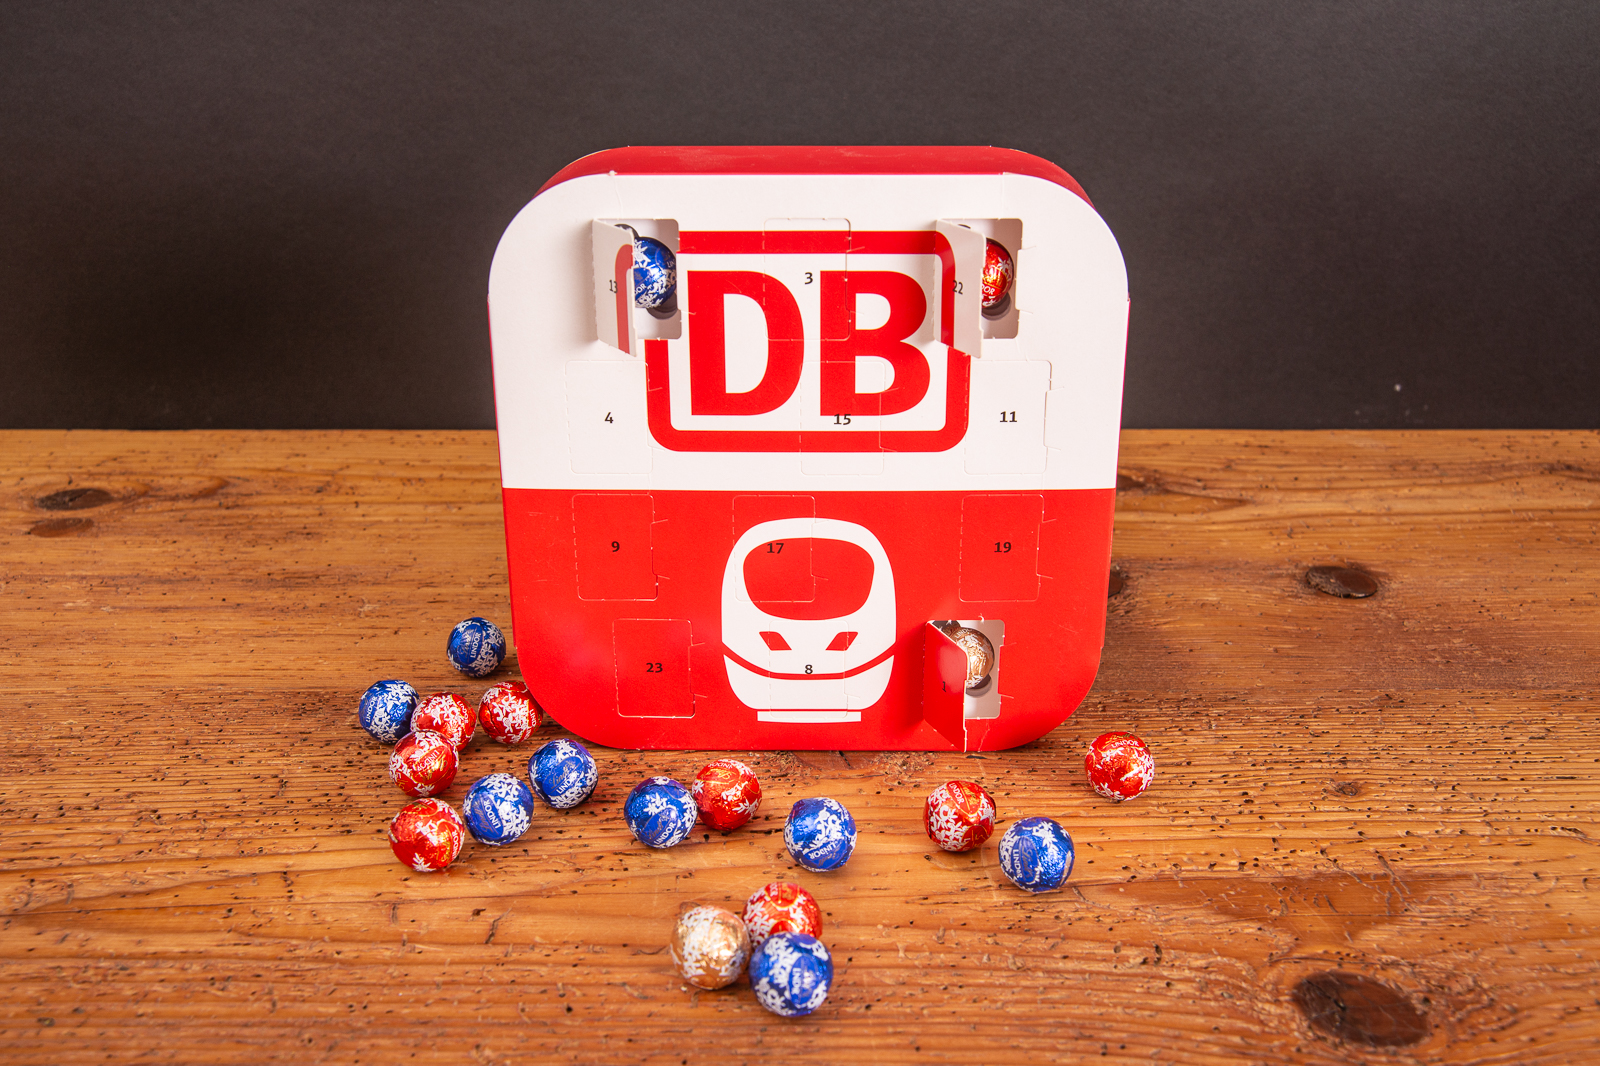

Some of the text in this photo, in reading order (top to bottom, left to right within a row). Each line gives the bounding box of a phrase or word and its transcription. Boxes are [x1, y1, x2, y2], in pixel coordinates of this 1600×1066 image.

[804, 272, 813, 285] 3
[609, 279, 618, 294] 13
[953, 279, 963, 295] 22
[688, 271, 930, 416] DB
[604, 412, 614, 424] 4
[833, 413, 851, 426] 15
[999, 411, 1018, 423] 11
[611, 541, 620, 553] 9
[767, 542, 784, 554] 17
[994, 541, 1012, 553] 19
[470, 632, 482, 658] LINDOR
[646, 662, 663, 673] 23
[804, 664, 813, 675] 8
[942, 681, 947, 693] 1
[365, 696, 378, 723] LINDOR
[948, 783, 965, 805] LINDOR
[483, 800, 501, 829] LINDOR
[653, 822, 677, 845] LINDOR
[808, 842, 837, 860] LINDOR
[1012, 849, 1022, 878] LINDOR
